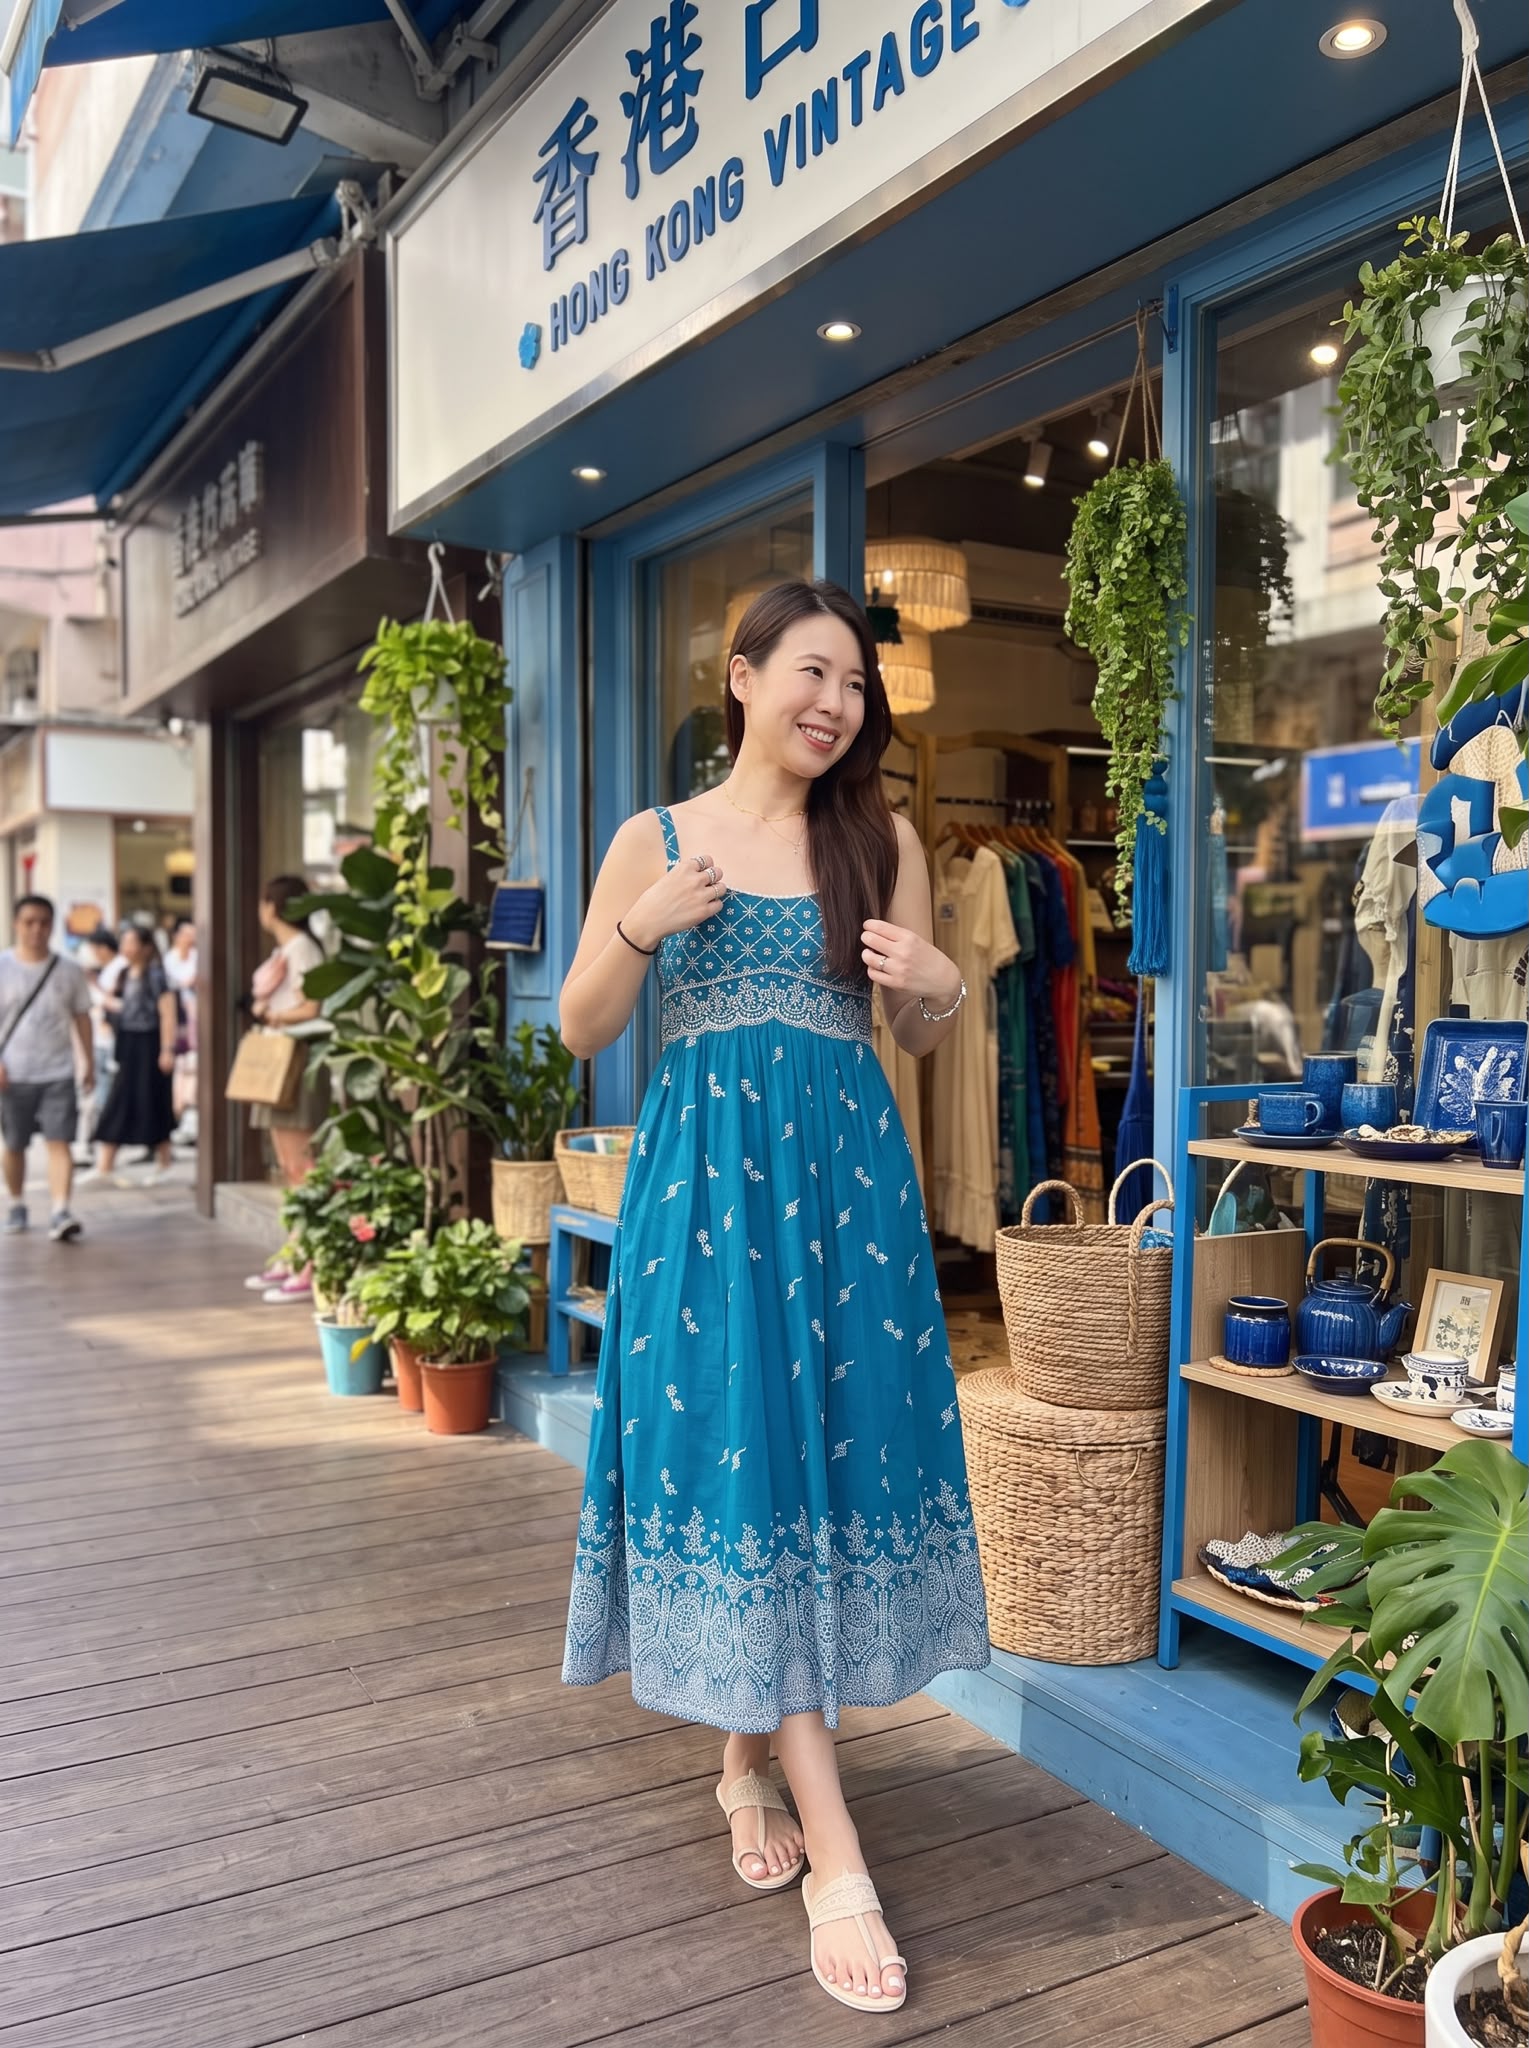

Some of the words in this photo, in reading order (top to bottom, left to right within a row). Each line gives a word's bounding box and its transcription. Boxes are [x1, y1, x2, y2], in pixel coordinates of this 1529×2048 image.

[550, 248, 629, 351] HONG
[645, 157, 744, 281] KONG
[763, 0, 980, 187] VINTAGE
